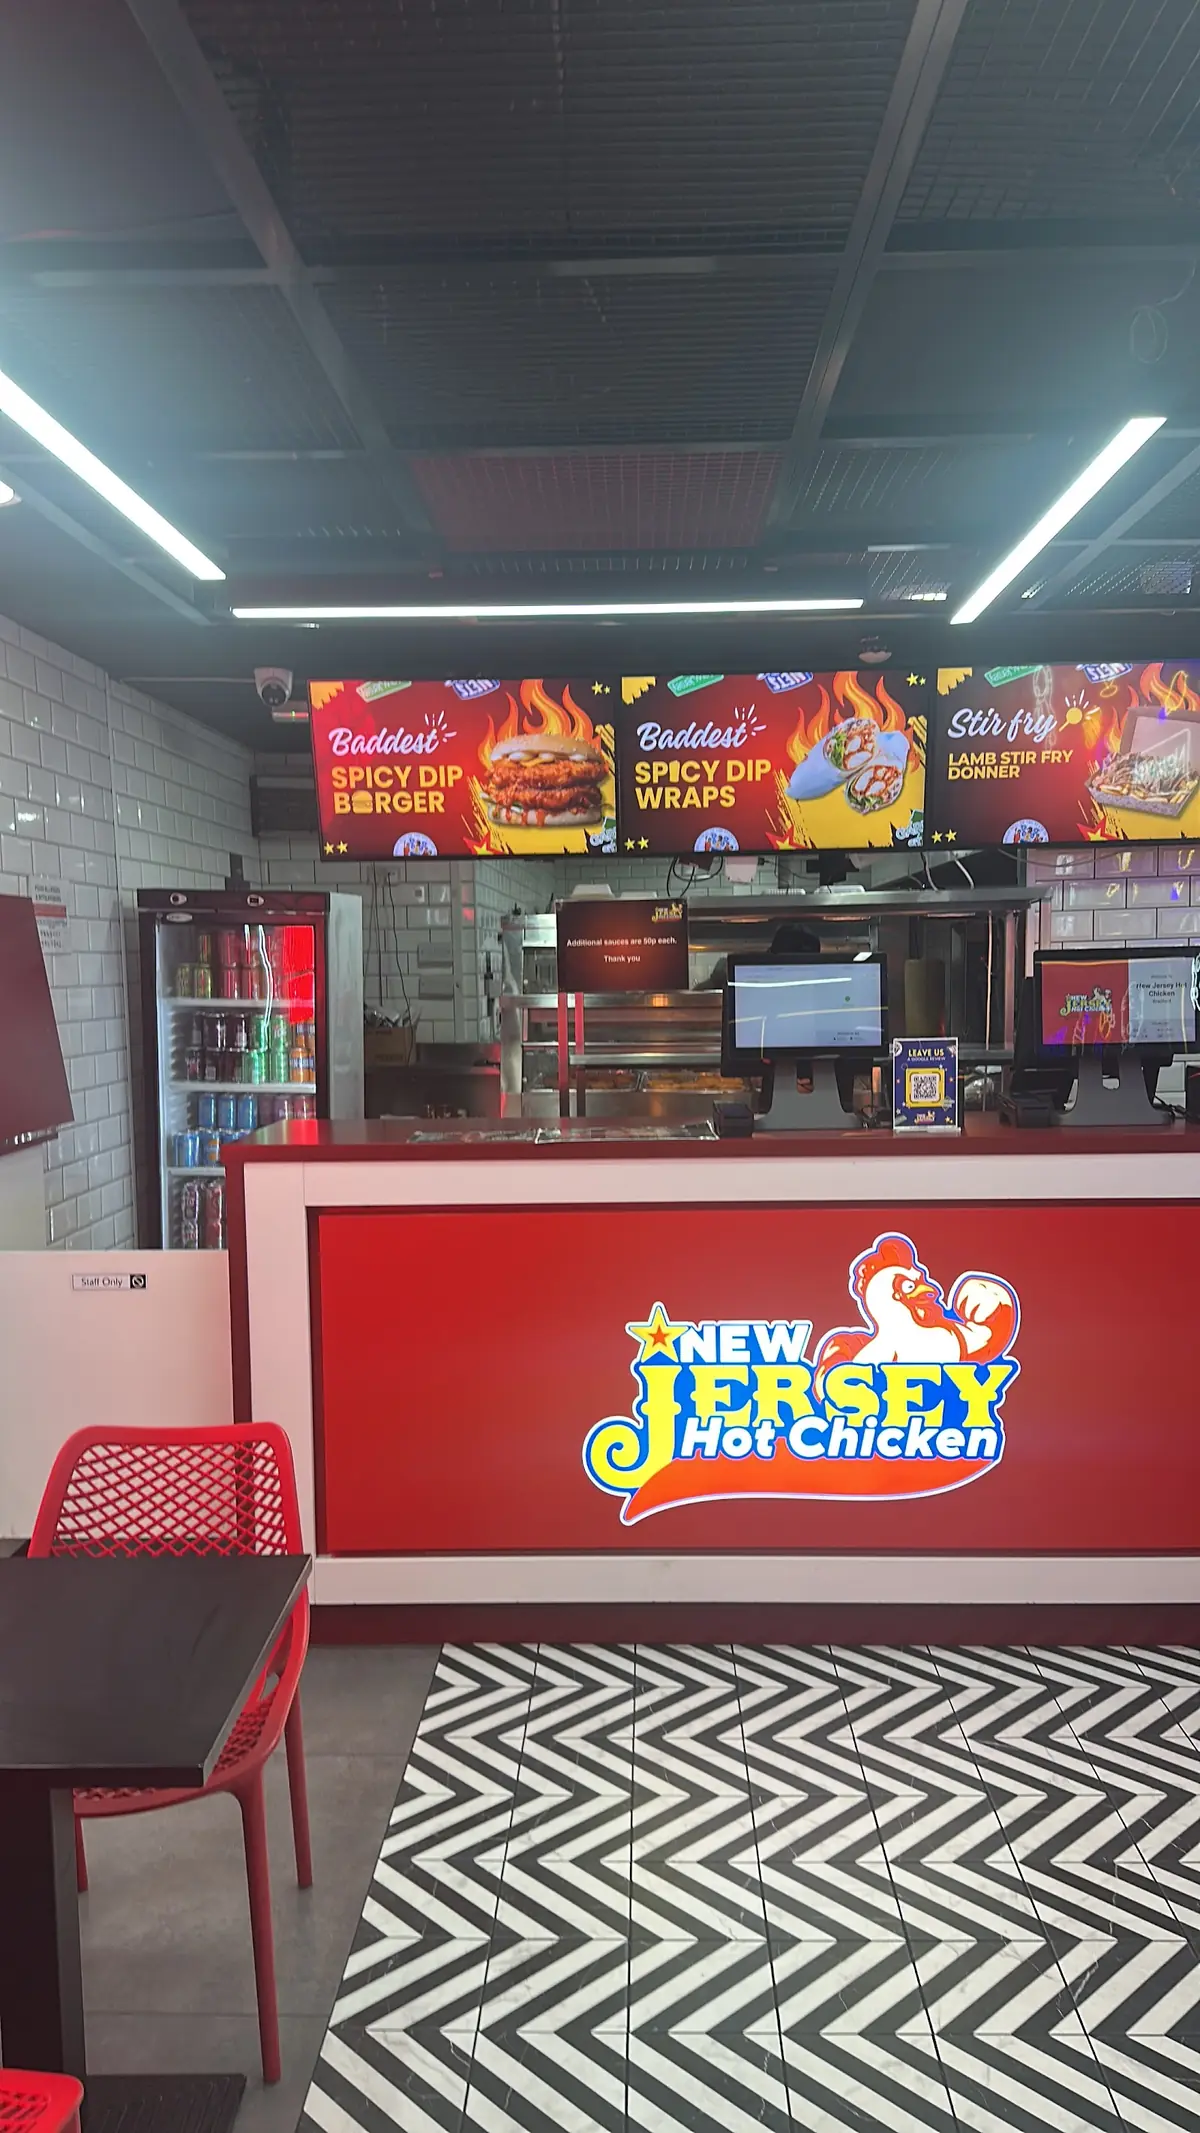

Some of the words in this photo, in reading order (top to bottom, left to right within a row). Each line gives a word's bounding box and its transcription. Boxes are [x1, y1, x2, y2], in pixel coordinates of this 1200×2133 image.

[636, 720, 747, 752] Baddest
[947, 706, 1006, 740] Stir
[1004, 708, 1057, 743] fry
[328, 725, 440, 757] Baddest
[948, 752, 997, 767] LAMB
[1000, 751, 1036, 765] STIR
[1041, 749, 1073, 763] FRY
[332, 765, 411, 789] SPICY
[419, 765, 464, 788] DIP
[635, 759, 720, 785] SPICY
[727, 759, 772, 782] DIP
[948, 765, 1020, 781] DONNER
[333, 790, 445, 815] BRGER
[635, 786, 736, 810] WRAPS
[566, 938, 602, 948] Additional
[604, 939, 629, 947] sauces
[603, 954, 625, 963] Thank
[626, 955, 641, 964] you
[908, 1049, 932, 1057] LEAVE
[934, 1048, 945, 1057] US
[81, 1276, 99, 1286] Staff
[102, 1277, 123, 1288] Only
[678, 1324, 810, 1363] NEW
[590, 1365, 1010, 1489] JERSEY
[682, 1416, 776, 1459] Hot
[787, 1416, 998, 1459] Chicken
